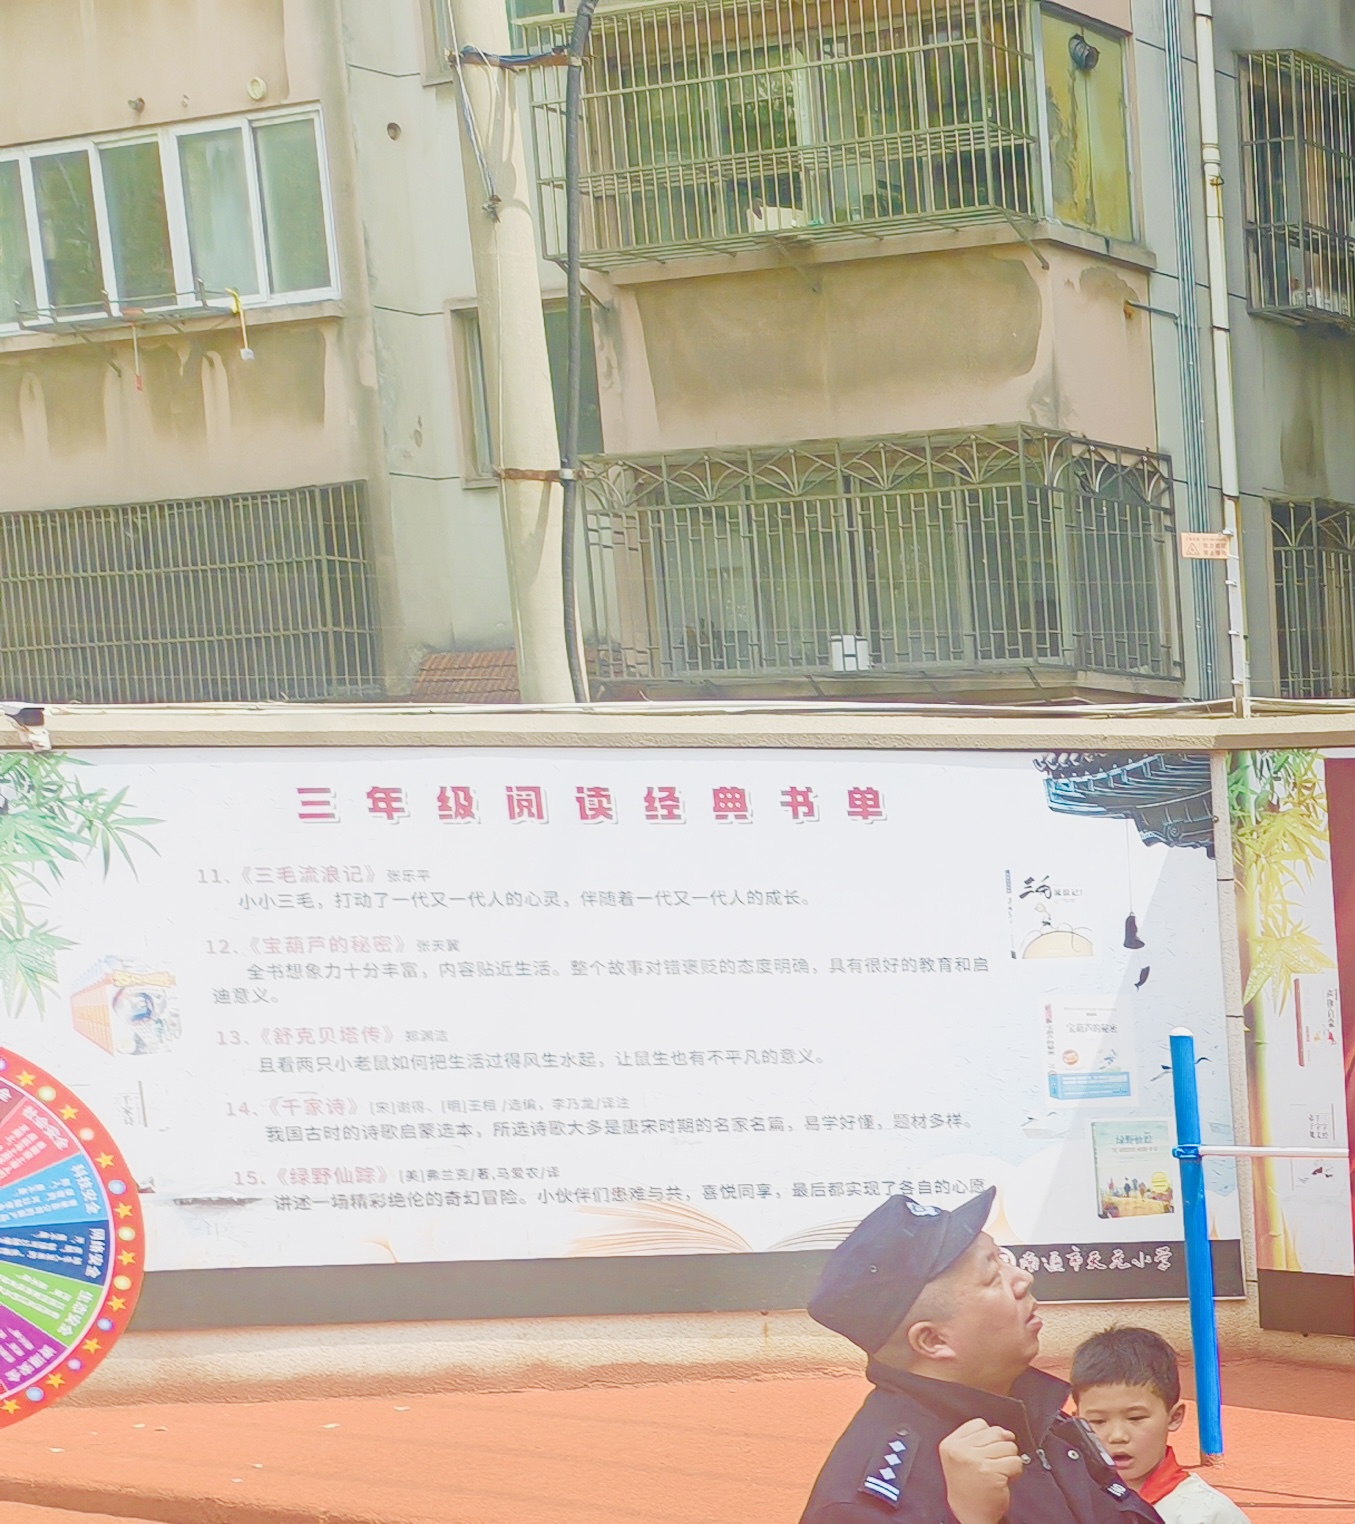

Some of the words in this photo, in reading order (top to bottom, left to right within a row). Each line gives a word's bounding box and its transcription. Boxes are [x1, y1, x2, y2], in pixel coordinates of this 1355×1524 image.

[297, 785, 885, 823] 三年级阅读经典书单
[198, 865, 377, 885] 11、《三毛流浪记》
[239, 889, 810, 911] 小小三毛，打动了一代又一代人的心灵，伴随着一代又一代人的成长。
[206, 935, 406, 956] 12、《宝葫芦的秘密》
[1018, 1245, 1173, 1273] 南通市天元小学
